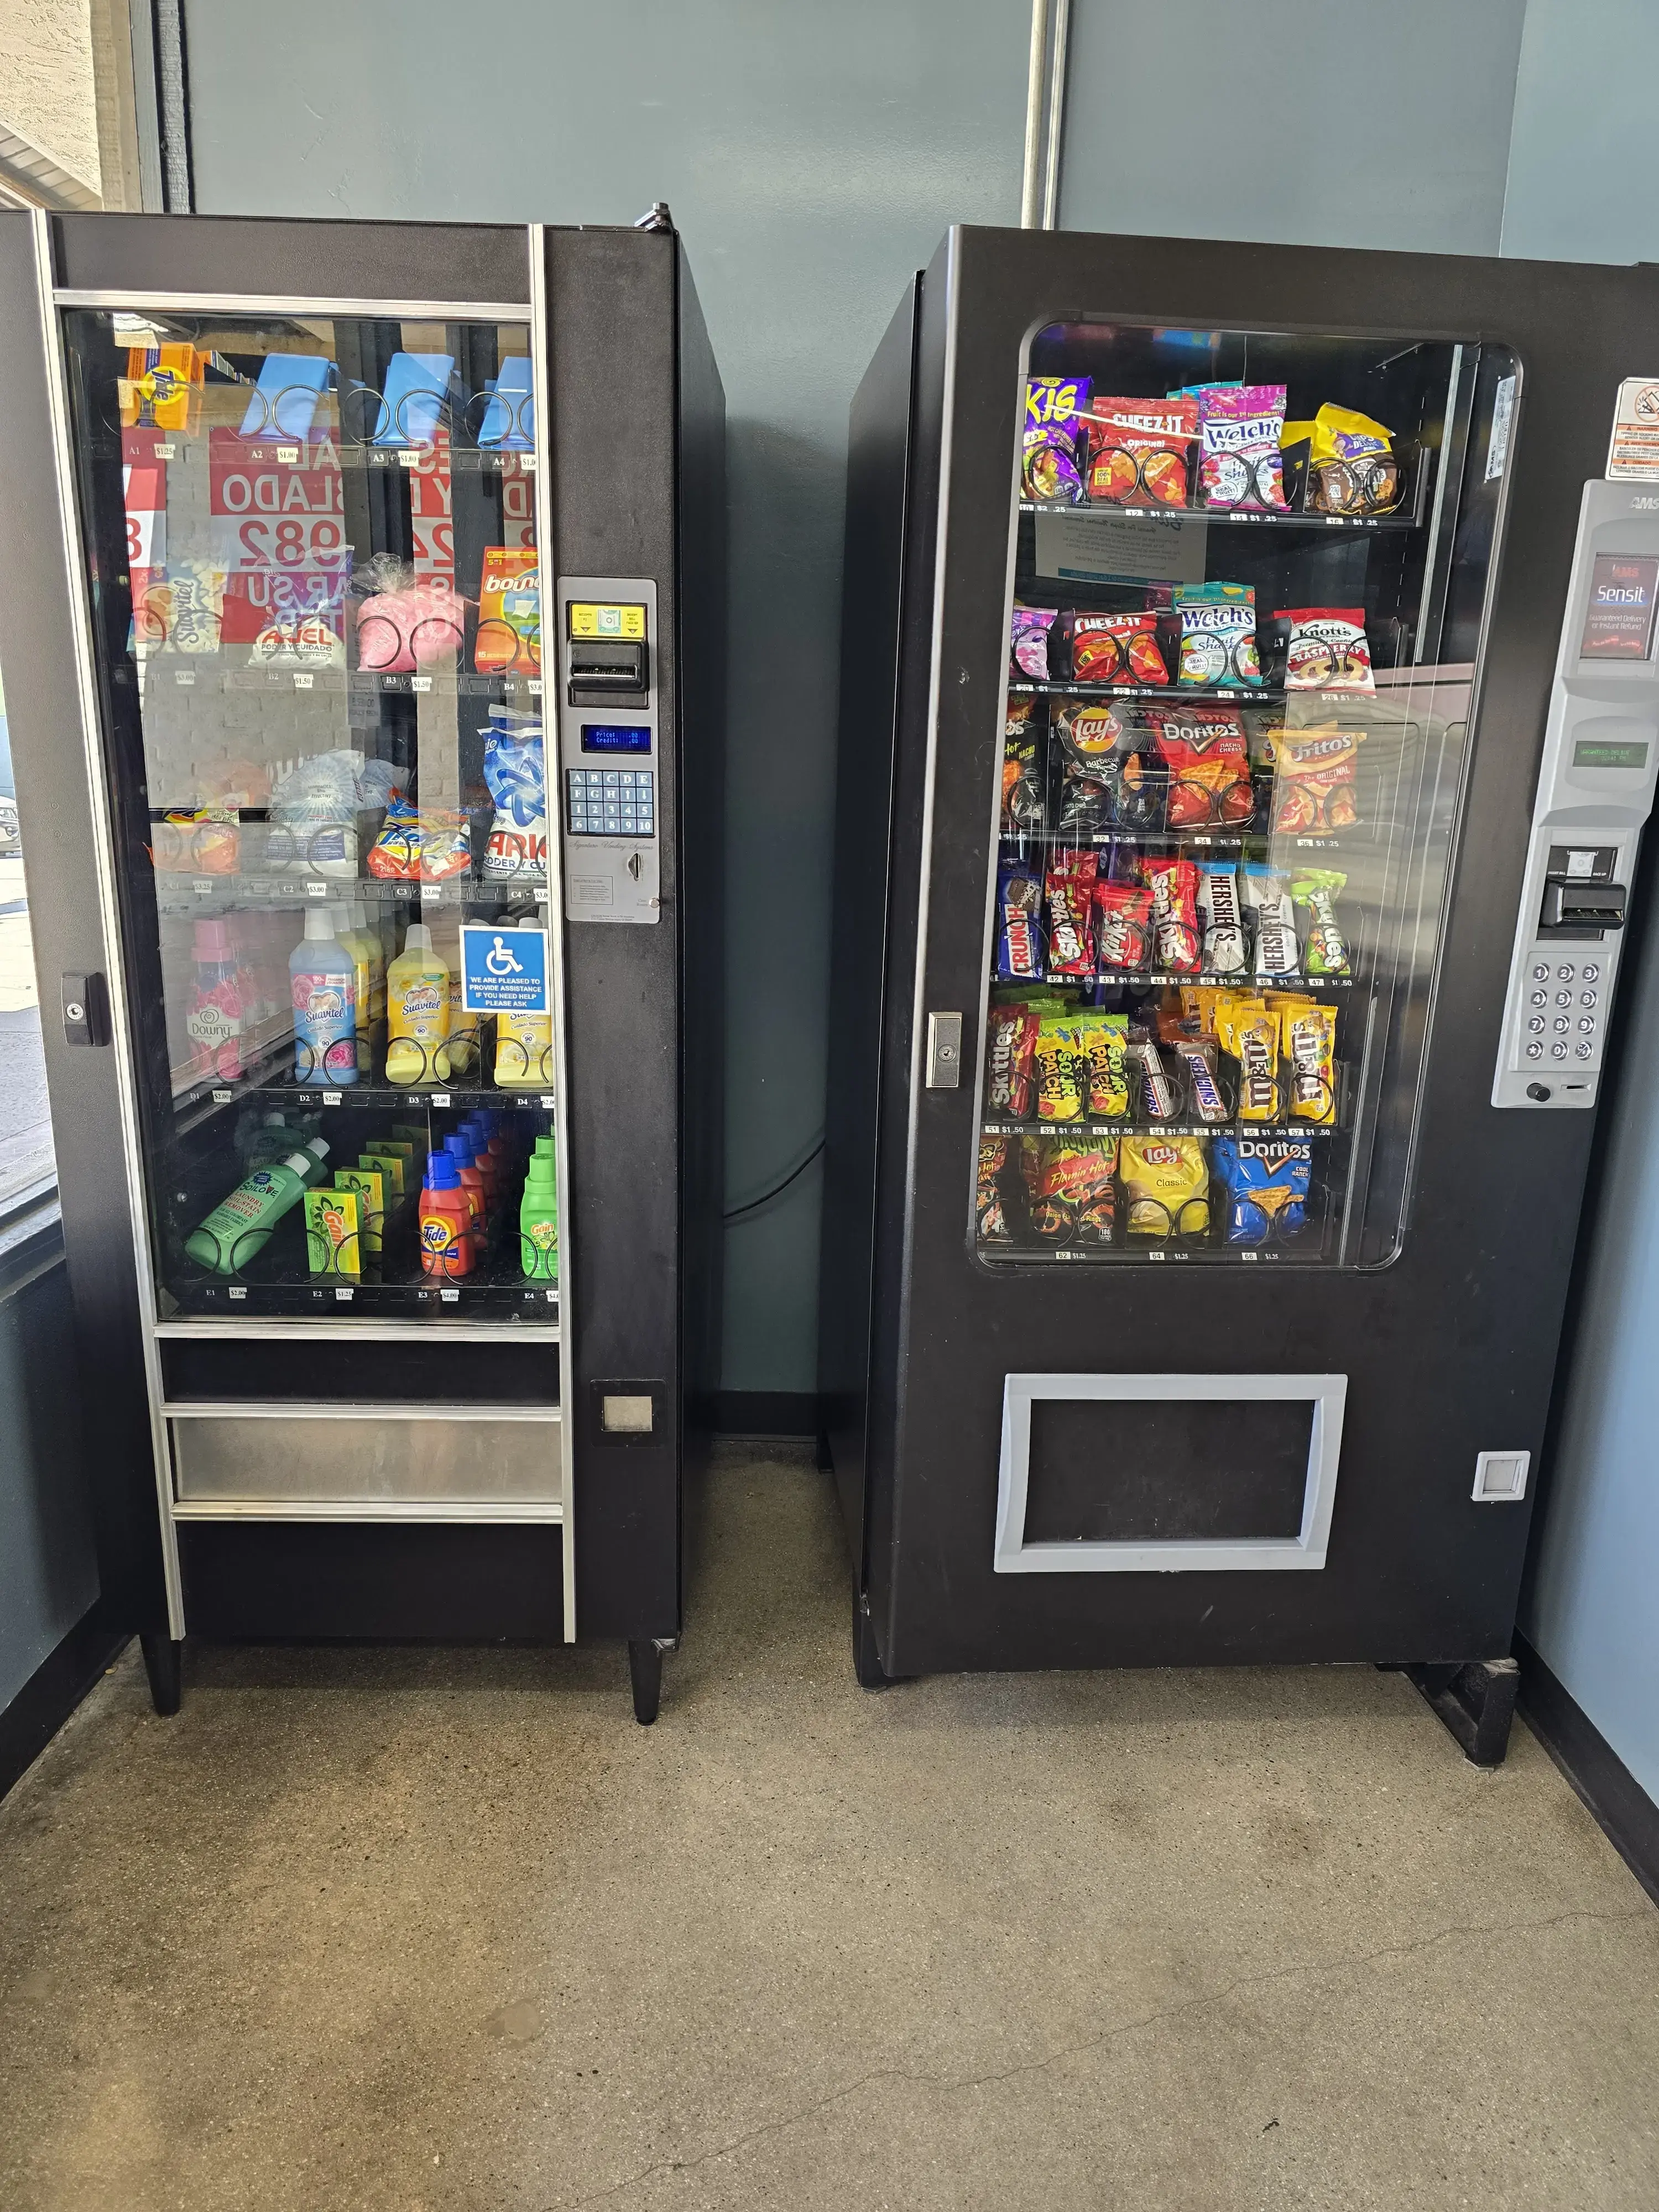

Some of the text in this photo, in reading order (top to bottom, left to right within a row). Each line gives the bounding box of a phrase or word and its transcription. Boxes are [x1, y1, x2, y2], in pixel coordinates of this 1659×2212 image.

[1113, 414, 1184, 434] CHEEZ-IT
[1206, 420, 1280, 447] Welch's
[1597, 585, 1645, 602] Sensit
[174, 579, 199, 644] Suavitel
[1180, 607, 1253, 627] Welch's
[1624, 615, 1646, 624] Delivery
[1075, 616, 1141, 632] CHEEZ-IT
[1298, 624, 1351, 637] Knott's
[1076, 716, 1120, 741] Lay's
[1164, 724, 1239, 740] Doritos
[1019, 745, 1035, 759] NACHO
[1293, 735, 1352, 761] Fritos
[1086, 757, 1119, 767] Barbecue
[1317, 766, 1350, 779] ORIGINAL
[609, 806, 614, 814] 3
[640, 822, 650, 830] 10
[568, 841, 654, 852] Signature Vending Systems
[1152, 875, 1182, 959] Skittles
[1210, 876, 1236, 941] HERSHEY'S
[1051, 889, 1081, 957] Skittles
[1008, 908, 1029, 974] CRUNCH
[1259, 904, 1285, 970] HERSHEY'S
[1537, 969, 1541, 977] 1
[306, 1008, 344, 1022] Suavitel
[402, 1001, 440, 1015] Suavitel
[192, 1024, 231, 1036] Downy
[993, 1021, 1014, 1104] Skittles
[1092, 1046, 1116, 1094] PATCH
[1108, 1046, 1127, 1093] SOUR
[1041, 1051, 1063, 1100] PATCH
[1058, 1051, 1076, 1096] SOUR
[1188, 1056, 1219, 1108] SNICKERS
[1239, 1141, 1310, 1159] Doritos
[1051, 1161, 1110, 1187] Flamin' Hot
[1156, 1178, 1187, 1187] Classic
[228, 1195, 260, 1214] SOIL-STAIN
[235, 1192, 264, 1207] LAUNDRY
[225, 1202, 254, 1218] REMOVER
[424, 1226, 447, 1242] Tide
[531, 1223, 554, 1235] Gain
